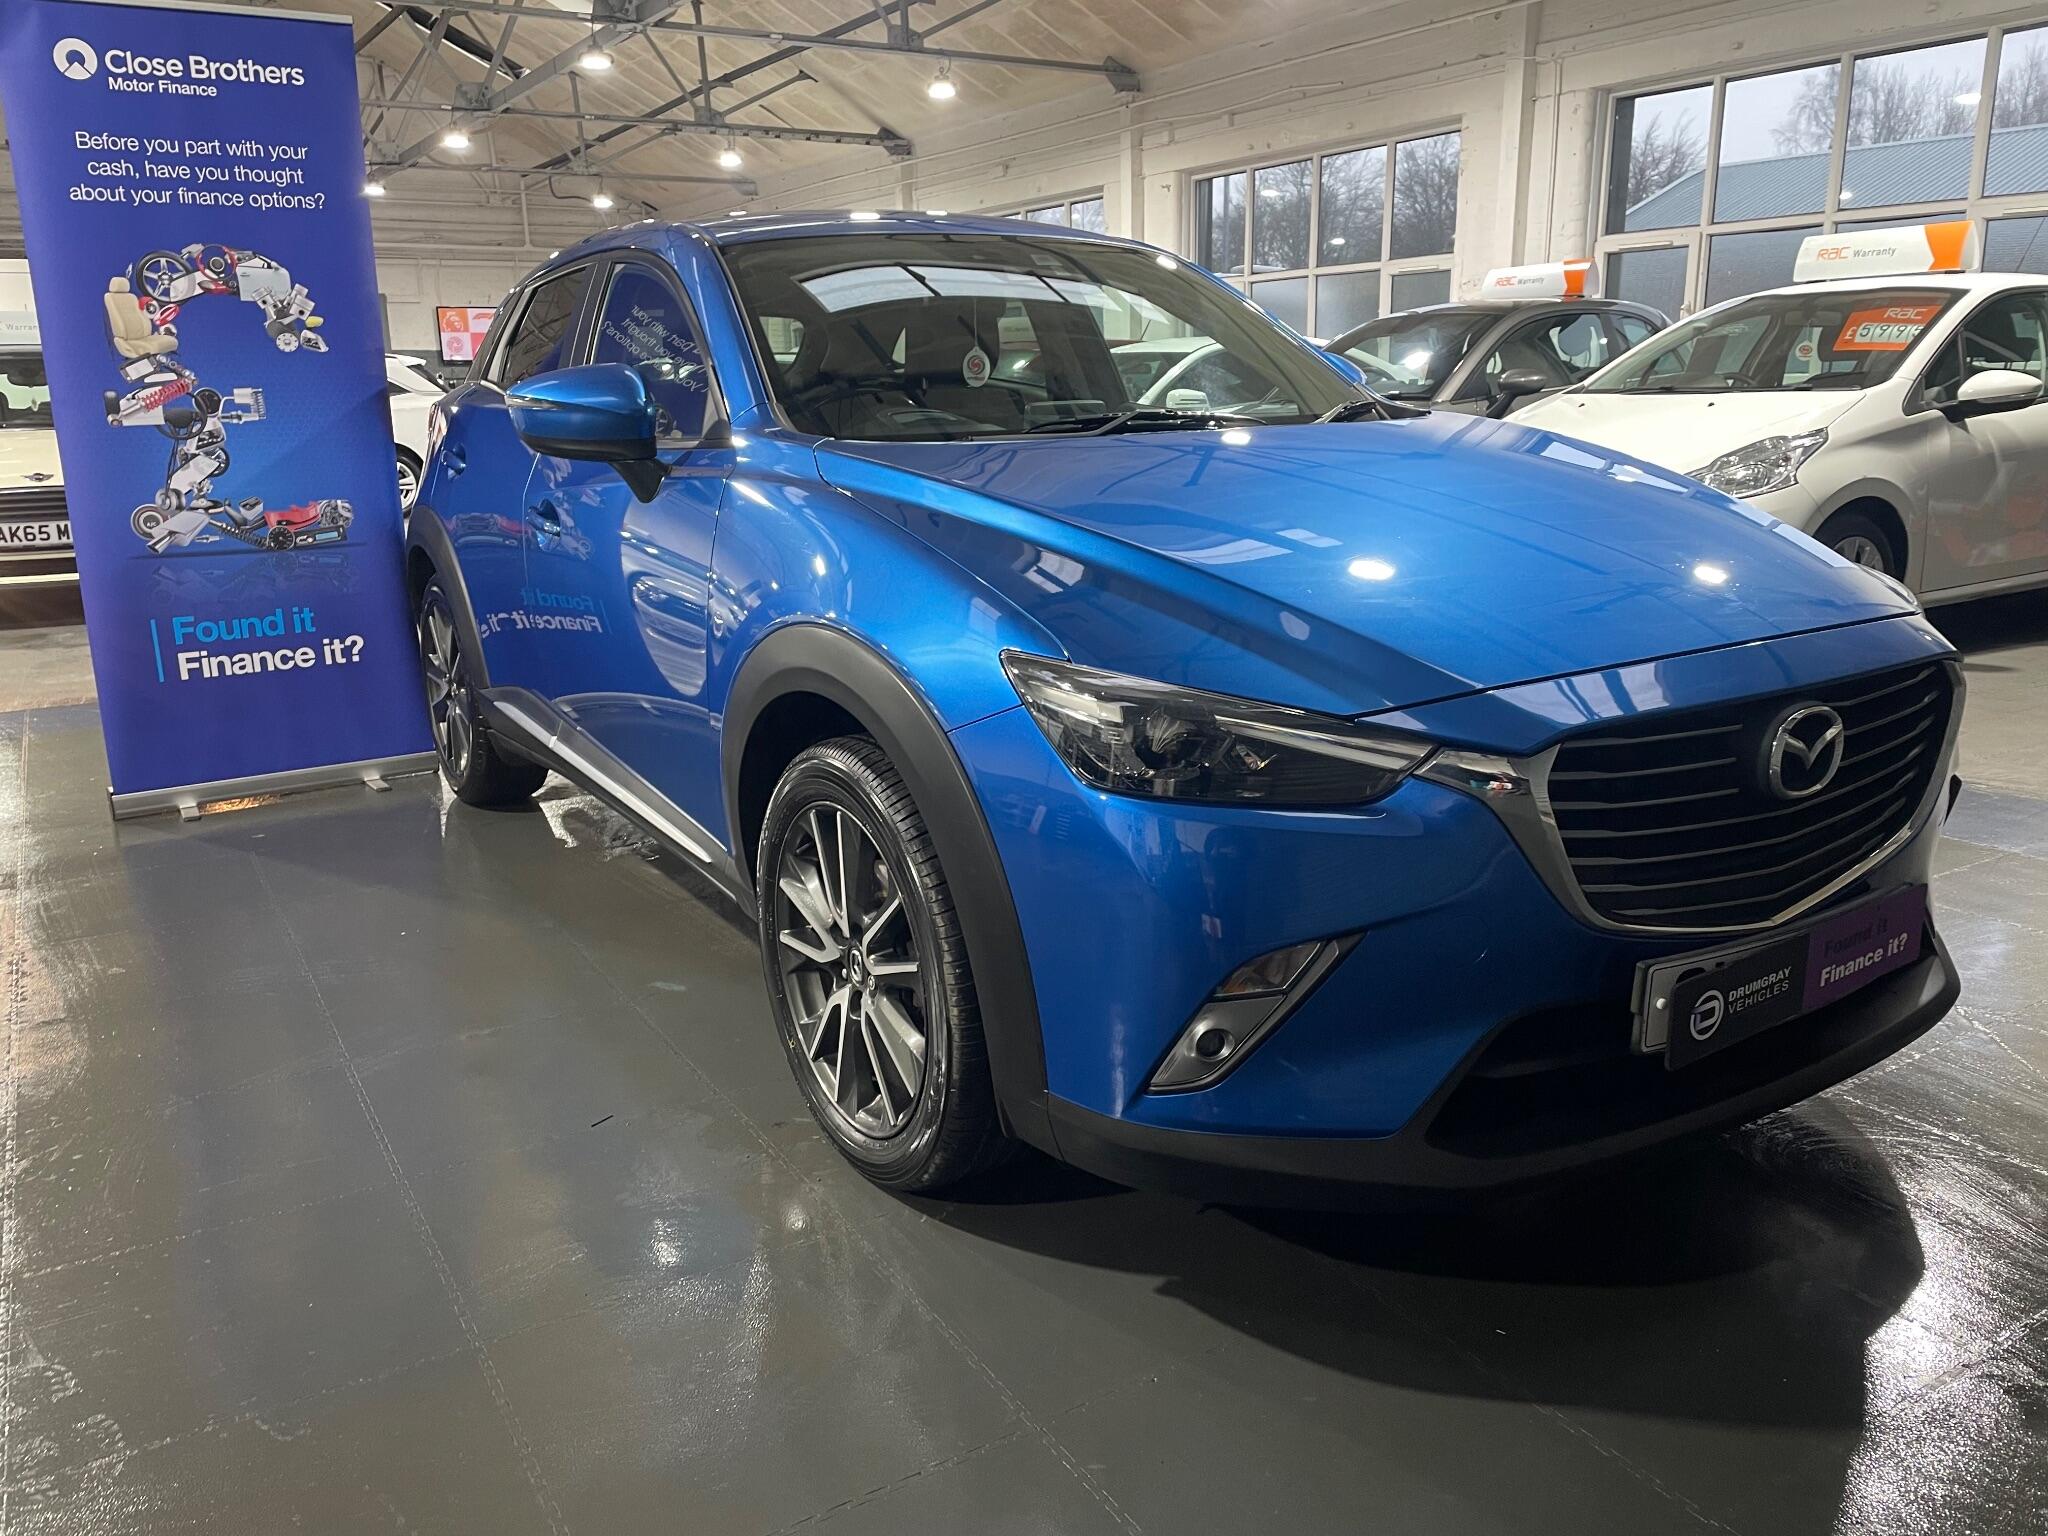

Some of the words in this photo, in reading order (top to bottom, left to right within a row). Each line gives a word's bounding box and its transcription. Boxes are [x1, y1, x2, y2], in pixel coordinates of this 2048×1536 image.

[104, 49, 184, 79] Close
[188, 55, 305, 86] Brothers
[108, 77, 155, 94] Motor
[159, 79, 218, 97] Finance
[75, 131, 140, 152] Before
[143, 138, 180, 156] you
[184, 139, 222, 157] part
[226, 140, 264, 158] with
[268, 144, 308, 162] your
[87, 160, 140, 179] cash,
[144, 161, 191, 180] have
[194, 166, 230, 184] you
[233, 165, 305, 188] thought
[69, 184, 126, 202] about
[130, 188, 173, 207] your
[177, 186, 245, 207] finance
[249, 191, 325, 211] options?
[1853, 247, 1897, 258] Warranty
[172, 608, 285, 645] Found
[292, 606, 316, 633] it
[177, 648, 316, 681] Finance
[323, 635, 364, 665] it?
[1820, 946, 1884, 987] Finance
[1887, 932, 1908, 957] it?
[1728, 966, 1792, 1002] DRUMGRAY
[1728, 980, 1790, 1014] VEHICLES
